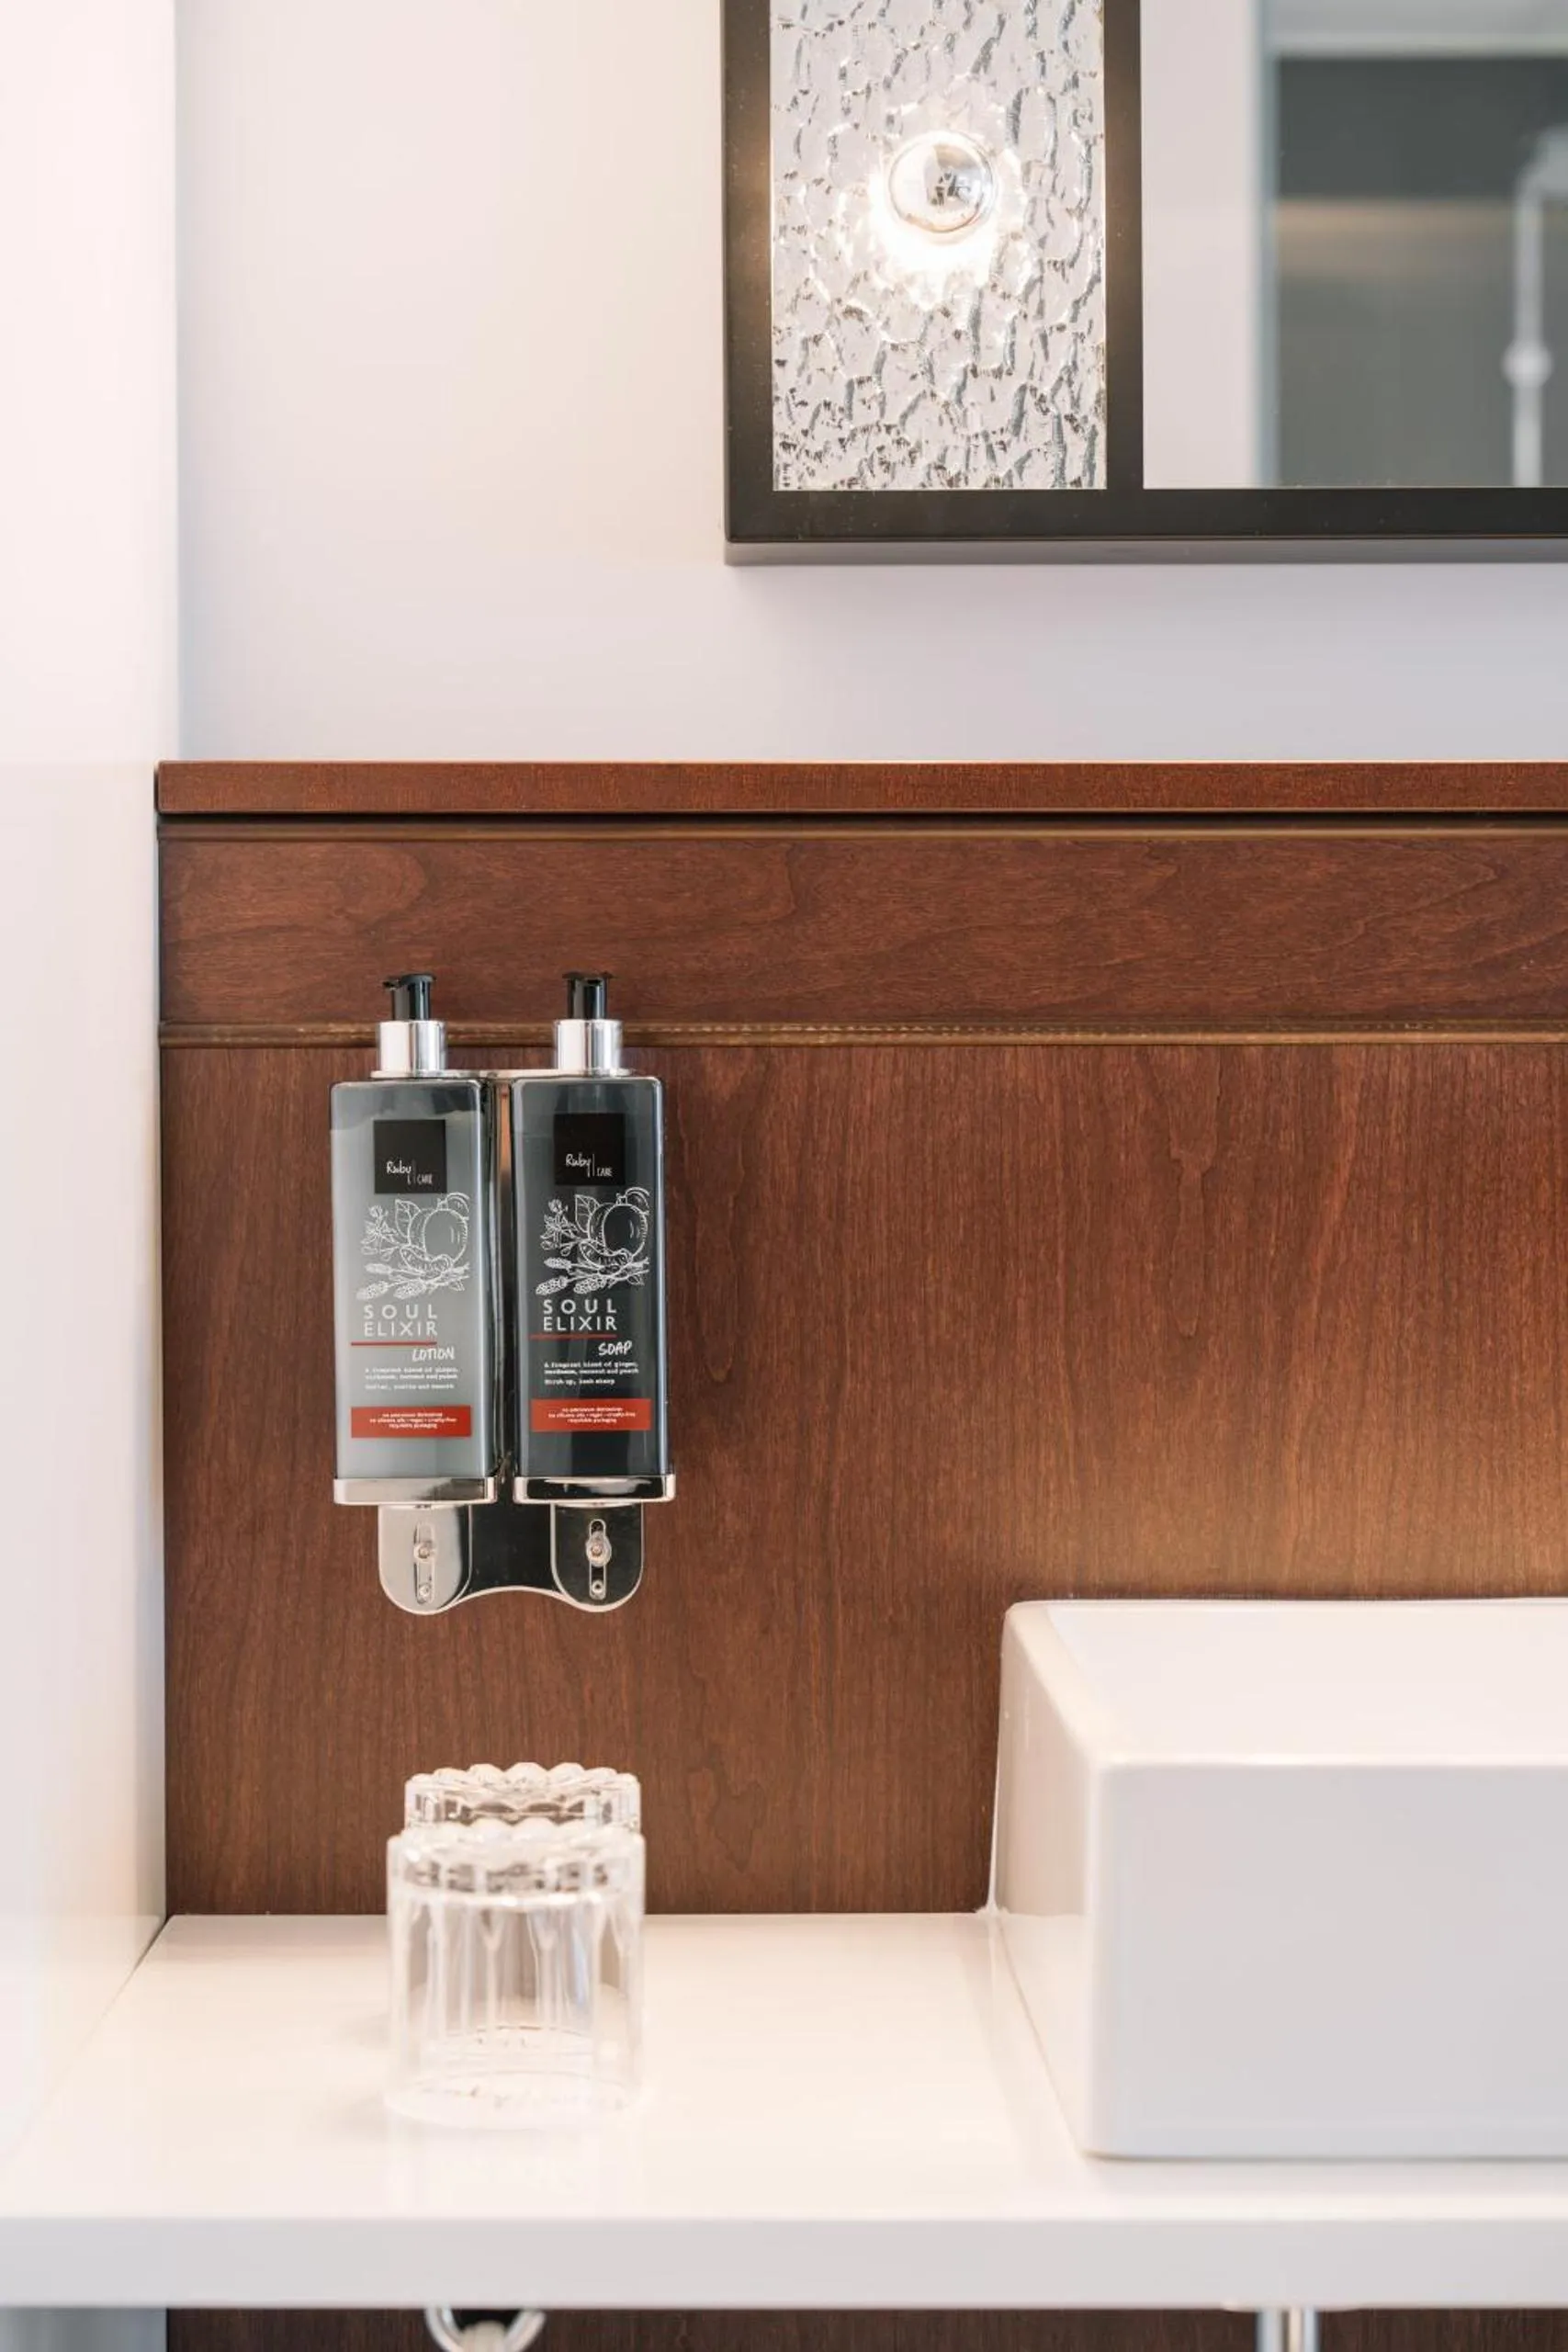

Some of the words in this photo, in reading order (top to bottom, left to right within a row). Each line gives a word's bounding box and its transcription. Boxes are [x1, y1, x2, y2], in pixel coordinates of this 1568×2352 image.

[387, 1159, 412, 1185] Ruby
[566, 1152, 591, 1177] Ruby
[364, 1304, 437, 1320] SOUL
[543, 1298, 616, 1315] SOUL
[365, 1321, 437, 1338] ELIXIR
[544, 1316, 617, 1331] ELIXIR
[412, 1346, 455, 1362] LOTION
[598, 1340, 633, 1356] SOAP
